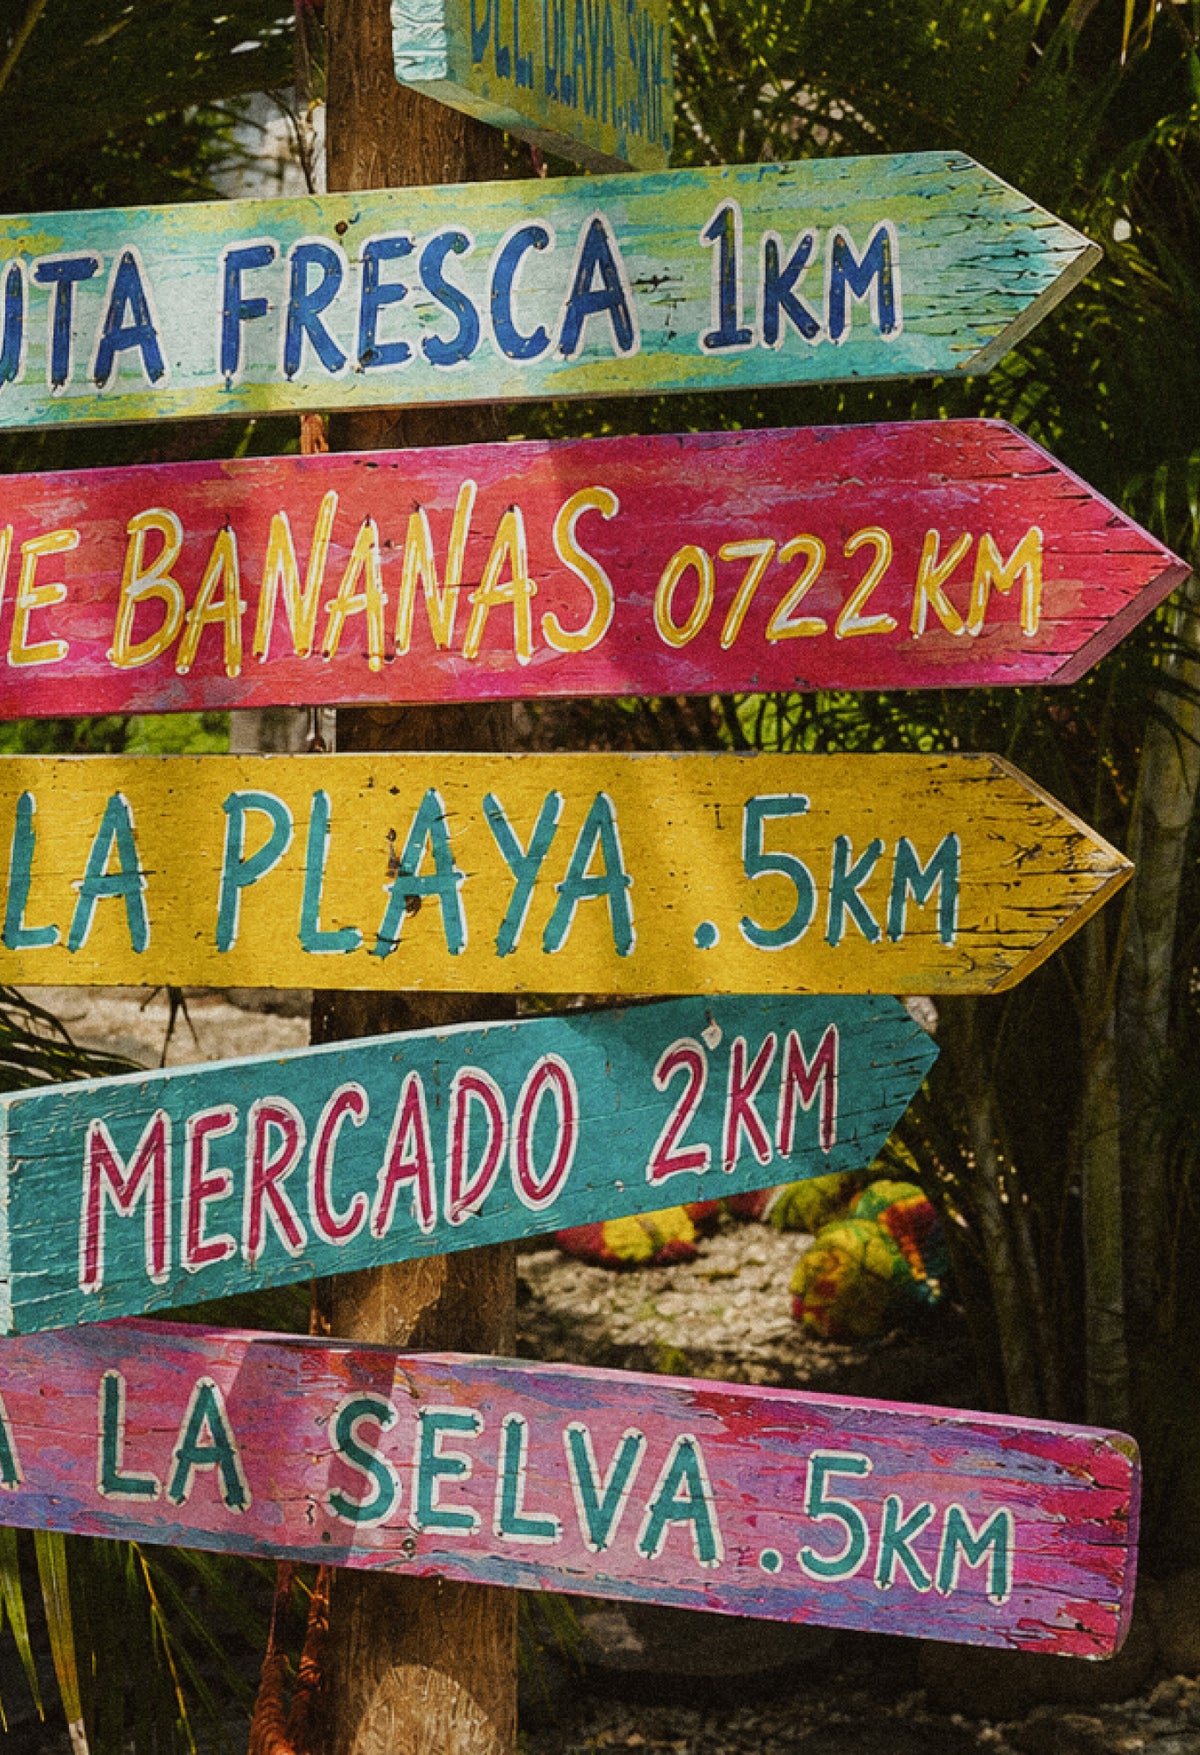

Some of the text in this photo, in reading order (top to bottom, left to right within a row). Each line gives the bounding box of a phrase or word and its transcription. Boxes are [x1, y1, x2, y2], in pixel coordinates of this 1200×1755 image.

[215, 210, 640, 386] FRESCA
[698, 197, 905, 356] 1KM
[107, 480, 620, 677] BANANAS
[2, 790, 151, 954] LA
[217, 788, 637, 958] PLAYA
[77, 1023, 841, 1294] MERCADO 2KM
[98, 1370, 253, 1514] LA
[326, 1392, 726, 1570] SELVA
